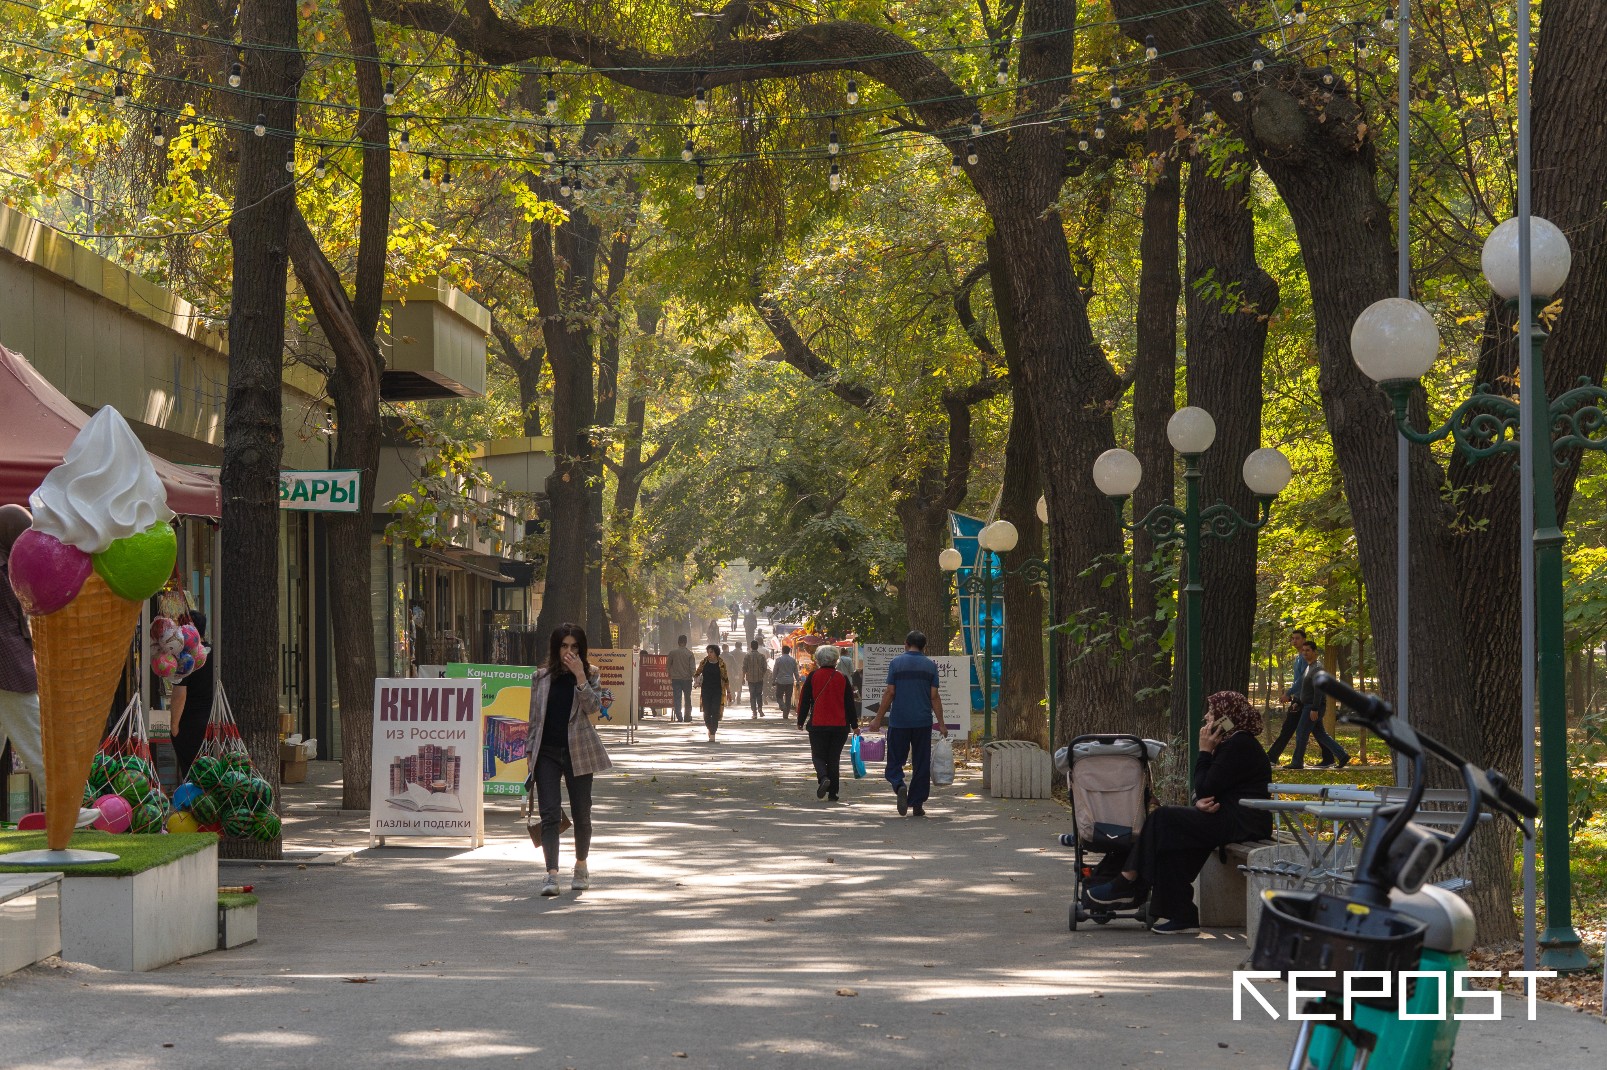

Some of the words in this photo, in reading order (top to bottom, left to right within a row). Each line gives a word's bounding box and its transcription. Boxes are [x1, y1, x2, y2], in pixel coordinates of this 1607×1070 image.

[467, 668, 532, 682] Канцтовары
[380, 687, 475, 721] КНИГИ
[386, 729, 405, 740] из
[410, 727, 467, 740] России
[376, 819, 411, 828] ПАЗЛЫ
[414, 819, 421, 828] И
[423, 819, 471, 830] ПОДЕЛКИ
